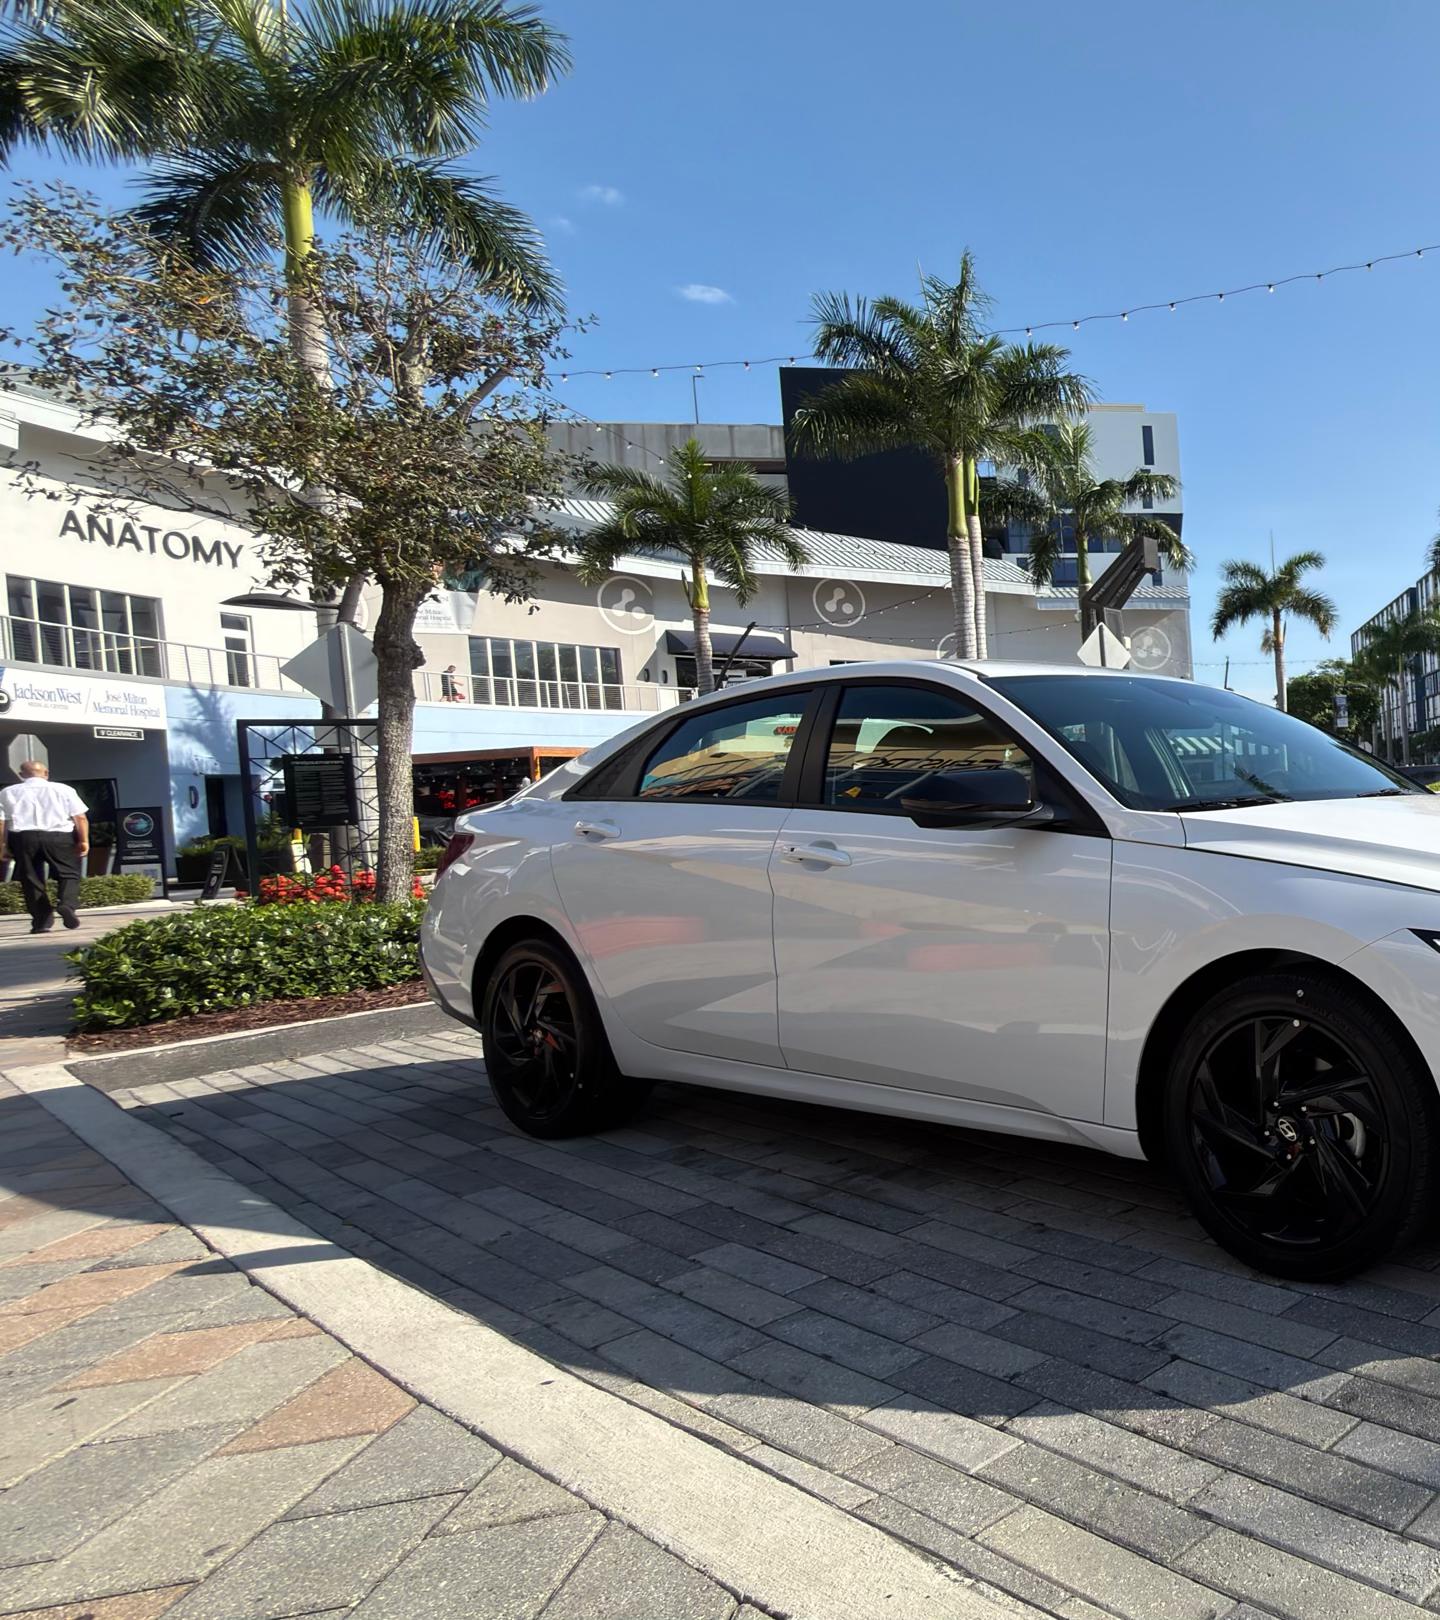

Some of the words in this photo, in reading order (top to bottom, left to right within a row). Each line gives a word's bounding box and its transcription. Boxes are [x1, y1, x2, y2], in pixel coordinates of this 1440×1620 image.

[58, 509, 245, 569] ANATOMY
[93, 701, 129, 716] Memorial
[130, 704, 161, 720] Hospital
